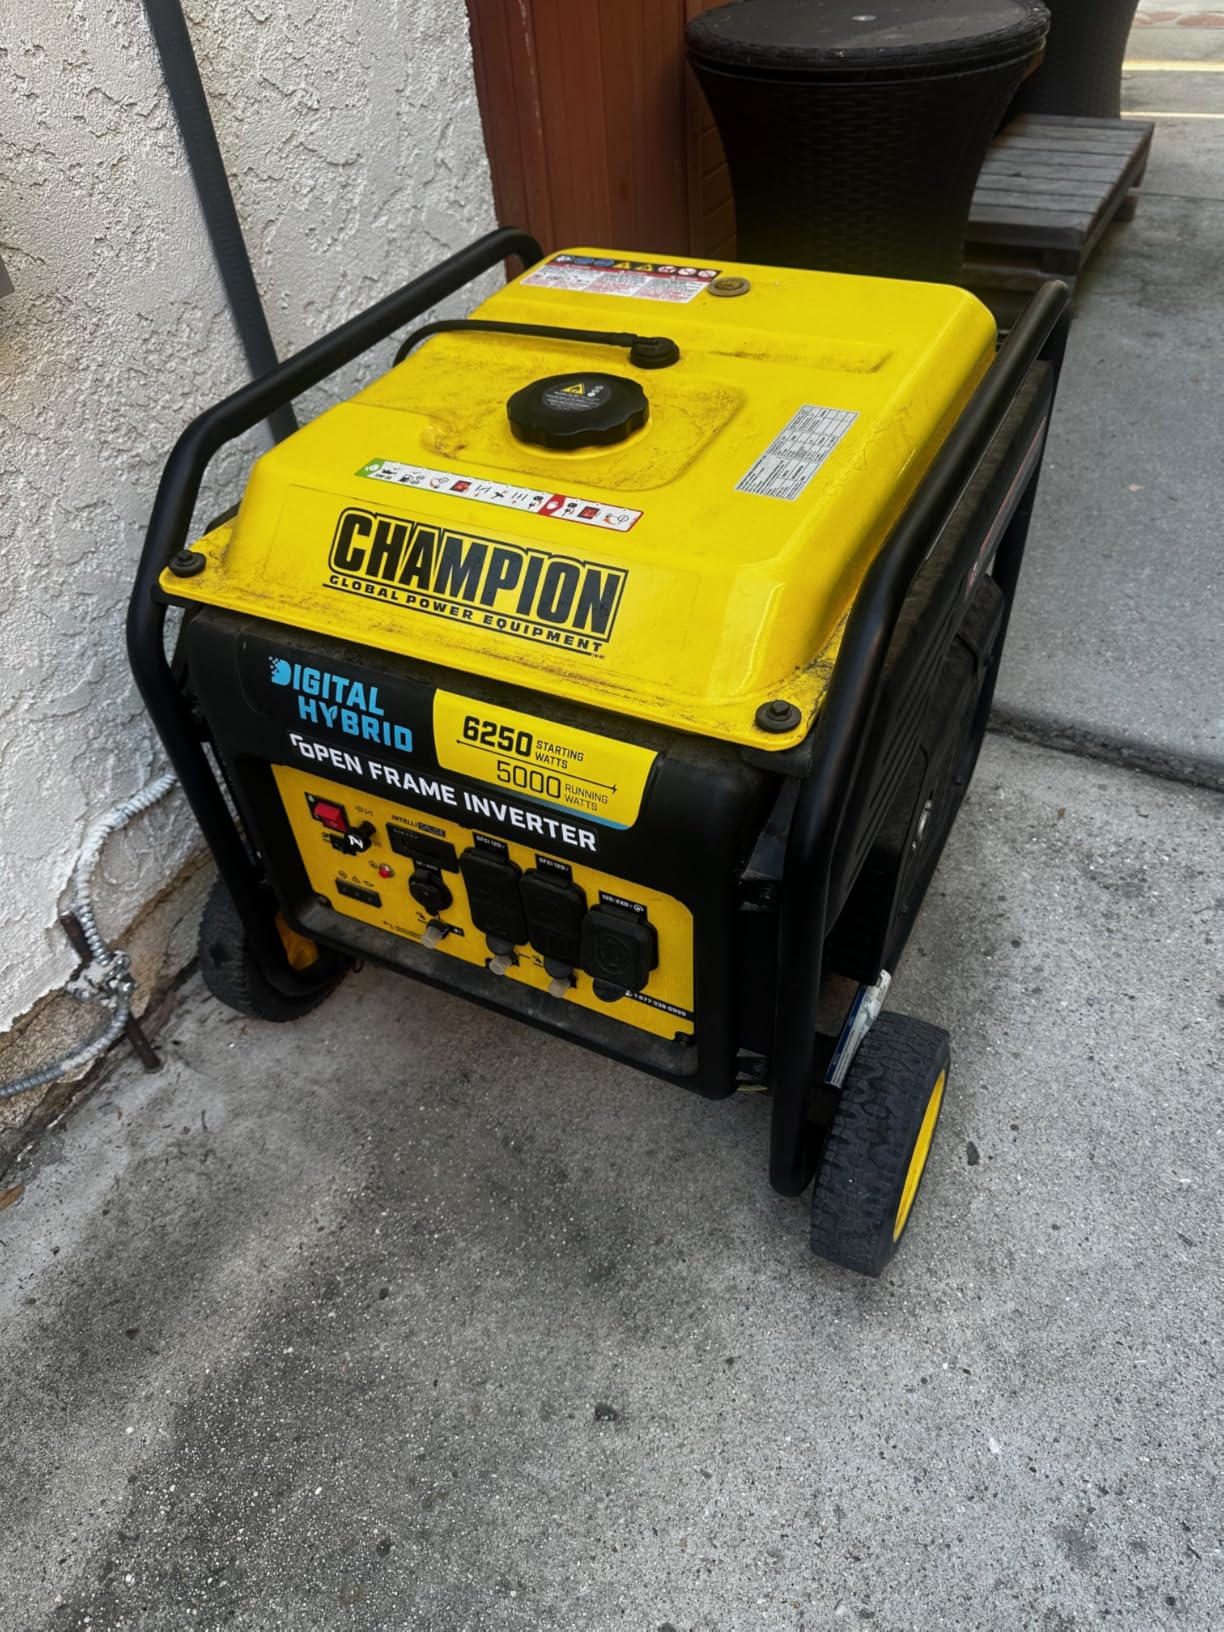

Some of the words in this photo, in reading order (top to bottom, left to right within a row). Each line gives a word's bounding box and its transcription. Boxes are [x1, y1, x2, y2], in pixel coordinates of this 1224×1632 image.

[332, 511, 624, 637] CHAMPION
[329, 575, 399, 601] GLOBAL
[406, 594, 473, 621] POWER
[482, 614, 604, 653] EQUIPMENT
[268, 656, 385, 716] DIGITAL
[298, 695, 413, 753] HYBRID
[463, 715, 533, 758] 6250
[536, 740, 584, 762] STARTING
[496, 759, 561, 799] 5000
[564, 783, 608, 804] RUNNING
[535, 751, 568, 769] WATTS
[289, 733, 363, 775] OPEN
[368, 760, 458, 806] FRAME
[464, 792, 597, 851] INVERTER
[564, 793, 598, 811] WATTS
